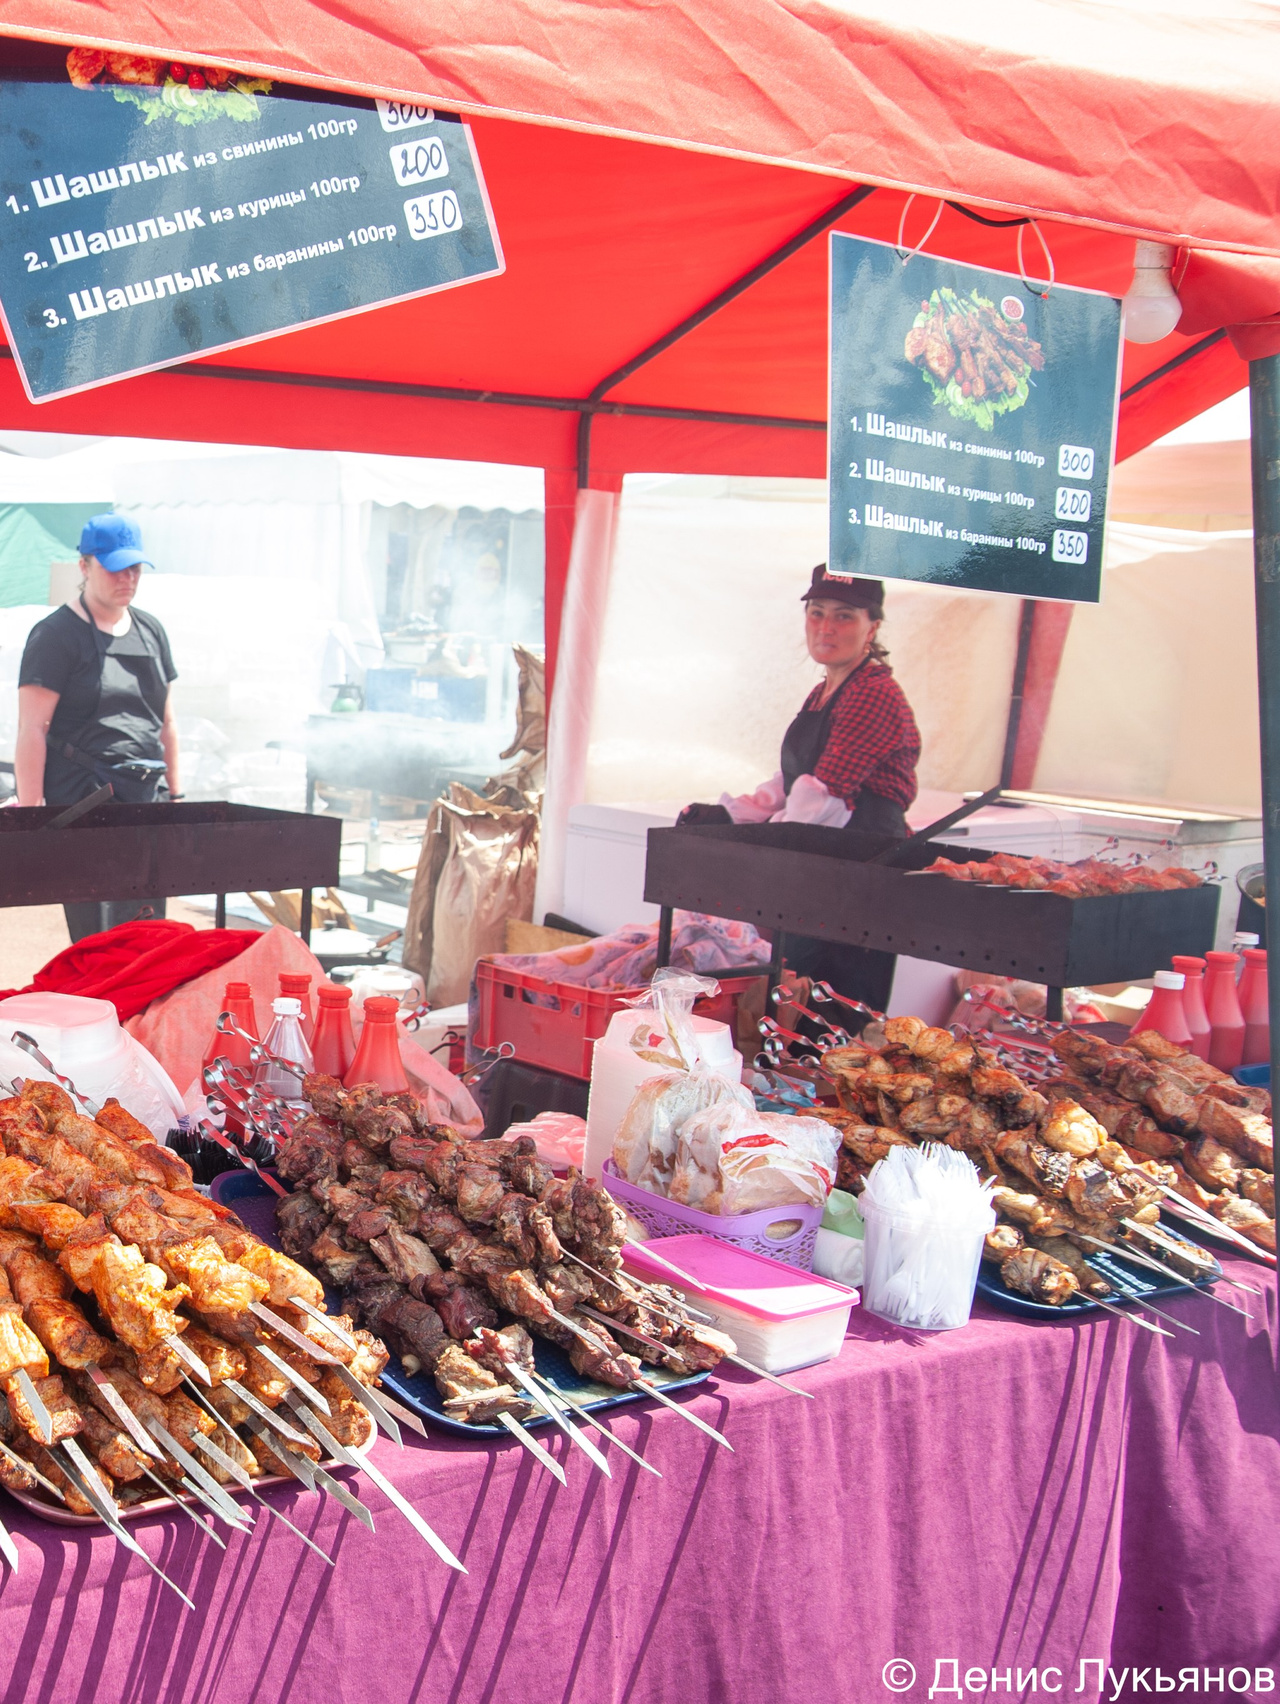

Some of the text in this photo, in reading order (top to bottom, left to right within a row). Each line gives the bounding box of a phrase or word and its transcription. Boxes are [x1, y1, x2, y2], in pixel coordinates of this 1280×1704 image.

[6, 194, 30, 215] 1.
[30, 151, 190, 209] Шашлык
[193, 152, 218, 168] из
[221, 131, 304, 161] свинины
[307, 118, 359, 140] 100гр
[23, 142, 443, 273] 2. Шашлык из курицы 100гр 200
[42, 195, 457, 329] 3. Шашлык из баранины 100гр 350
[850, 412, 1091, 473] 1. Шашлык из свинины 100гр 300
[848, 458, 1089, 516] 2. Шашлык из курицы 100гр 200
[848, 504, 1085, 558] 3. Шашлык из баранины 100гр 350
